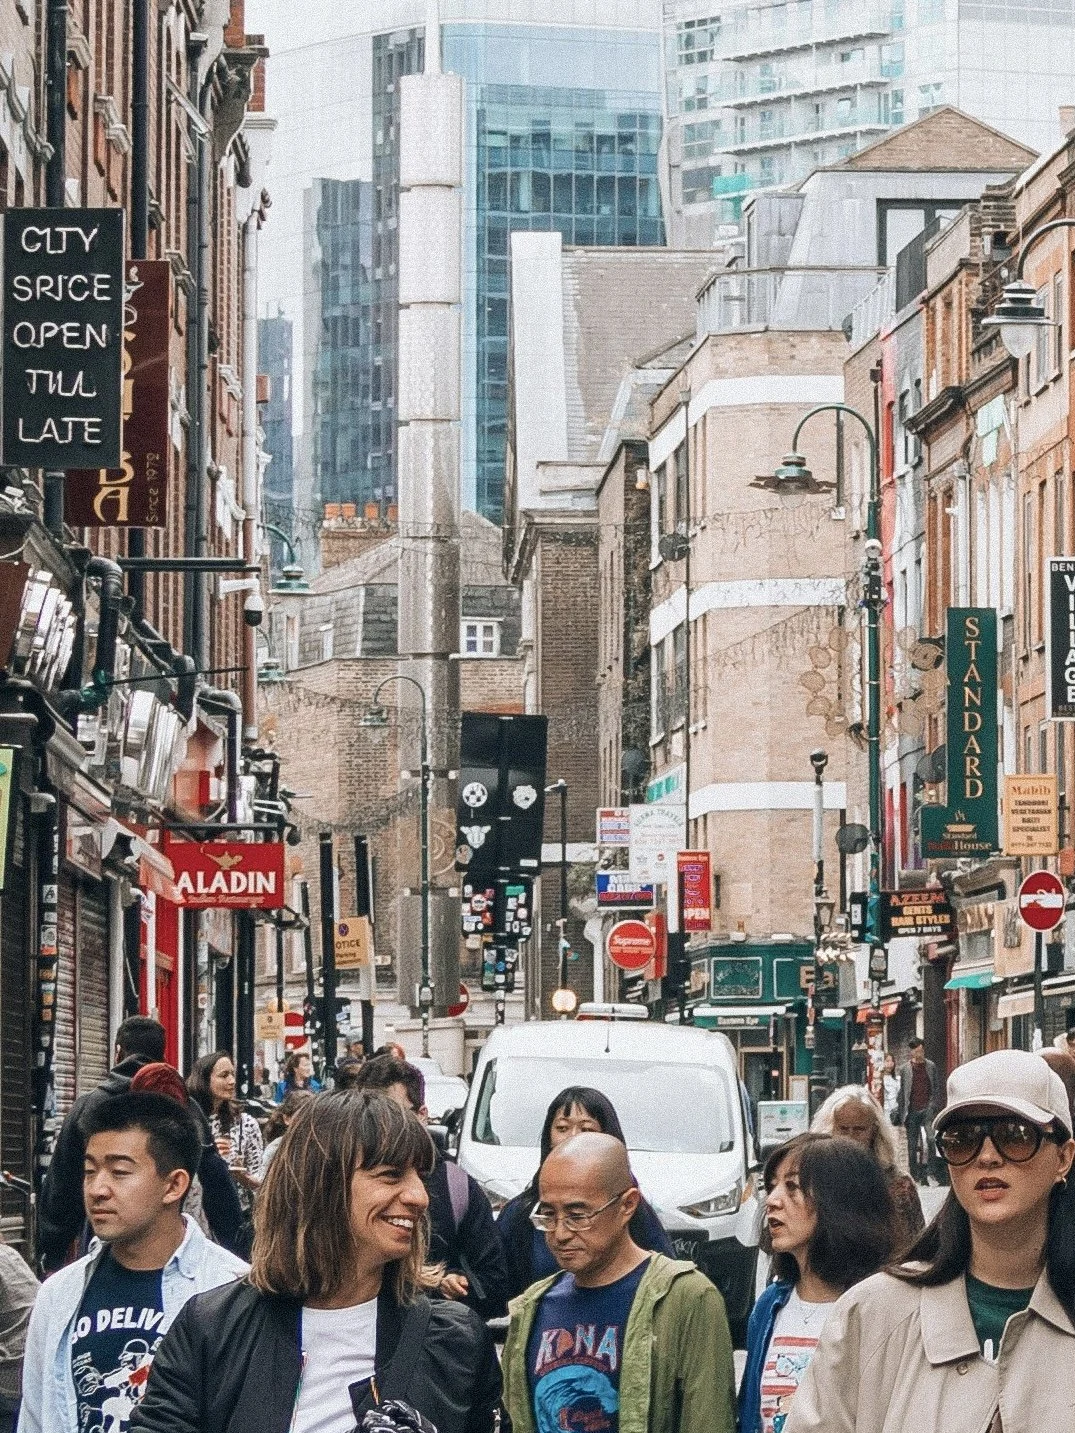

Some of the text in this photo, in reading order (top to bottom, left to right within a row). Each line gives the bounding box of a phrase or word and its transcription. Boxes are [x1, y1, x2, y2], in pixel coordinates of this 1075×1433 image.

[21, 225, 98, 254] CITY
[13, 321, 108, 349] OPEN
[25, 369, 97, 397] TILL
[18, 416, 102, 444] LATE
[963, 616, 984, 800] STANDARD
[176, 871, 276, 894] ALADIN
[890, 892, 948, 907] AZEEM
[335, 938, 362, 950] OTICE
